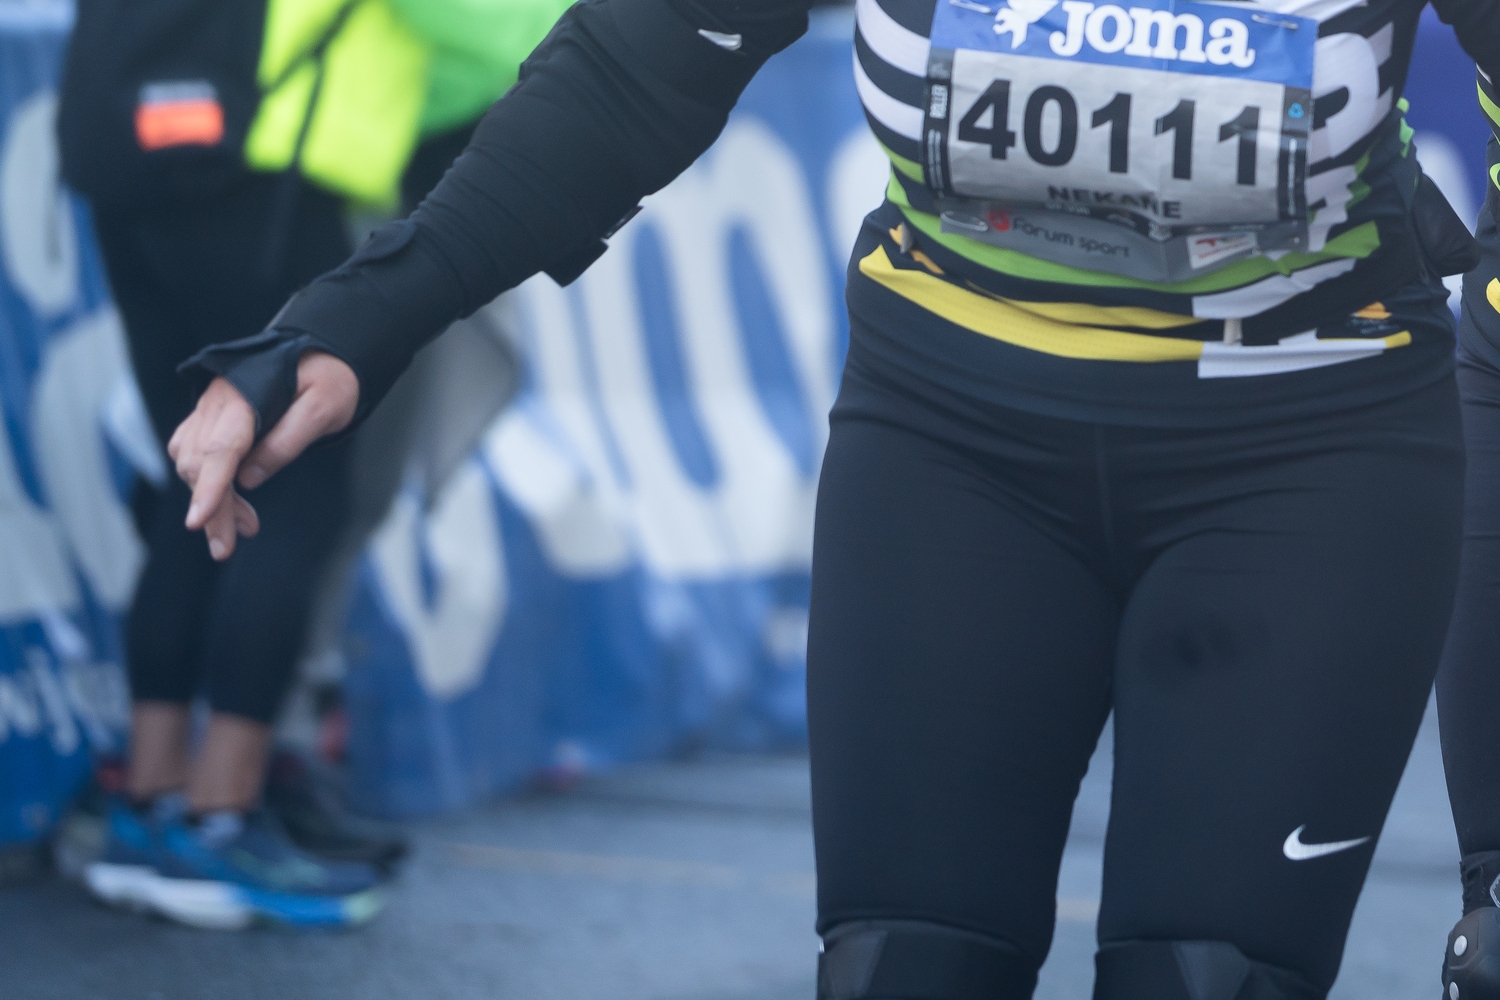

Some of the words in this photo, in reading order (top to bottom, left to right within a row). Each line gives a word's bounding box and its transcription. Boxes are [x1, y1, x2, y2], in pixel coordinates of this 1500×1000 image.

[1049, 0, 1256, 68] Joma
[957, 78, 1261, 187] 40111
[1079, 235, 1130, 258] sport
